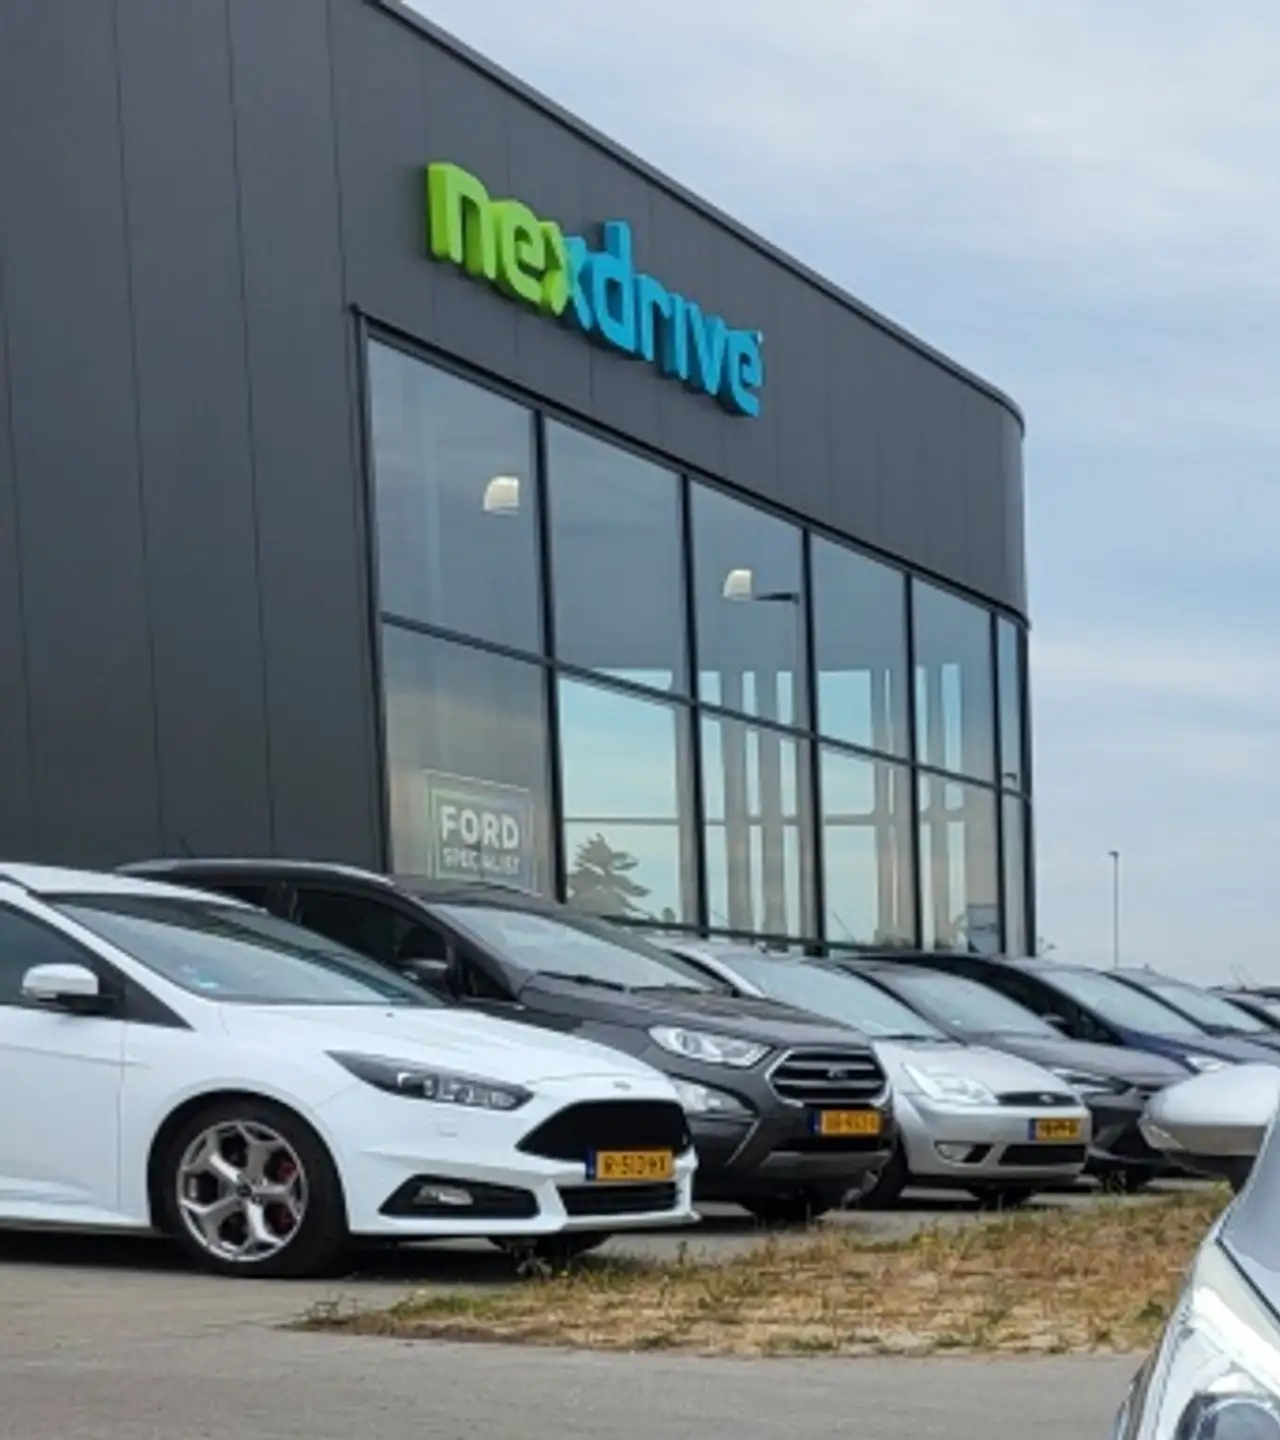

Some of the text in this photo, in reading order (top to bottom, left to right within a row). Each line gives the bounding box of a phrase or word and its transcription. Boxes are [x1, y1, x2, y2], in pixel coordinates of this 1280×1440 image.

[426, 162, 763, 417] nexdrive
[441, 805, 520, 849] FORD
[442, 847, 520, 876] SPECALIST
